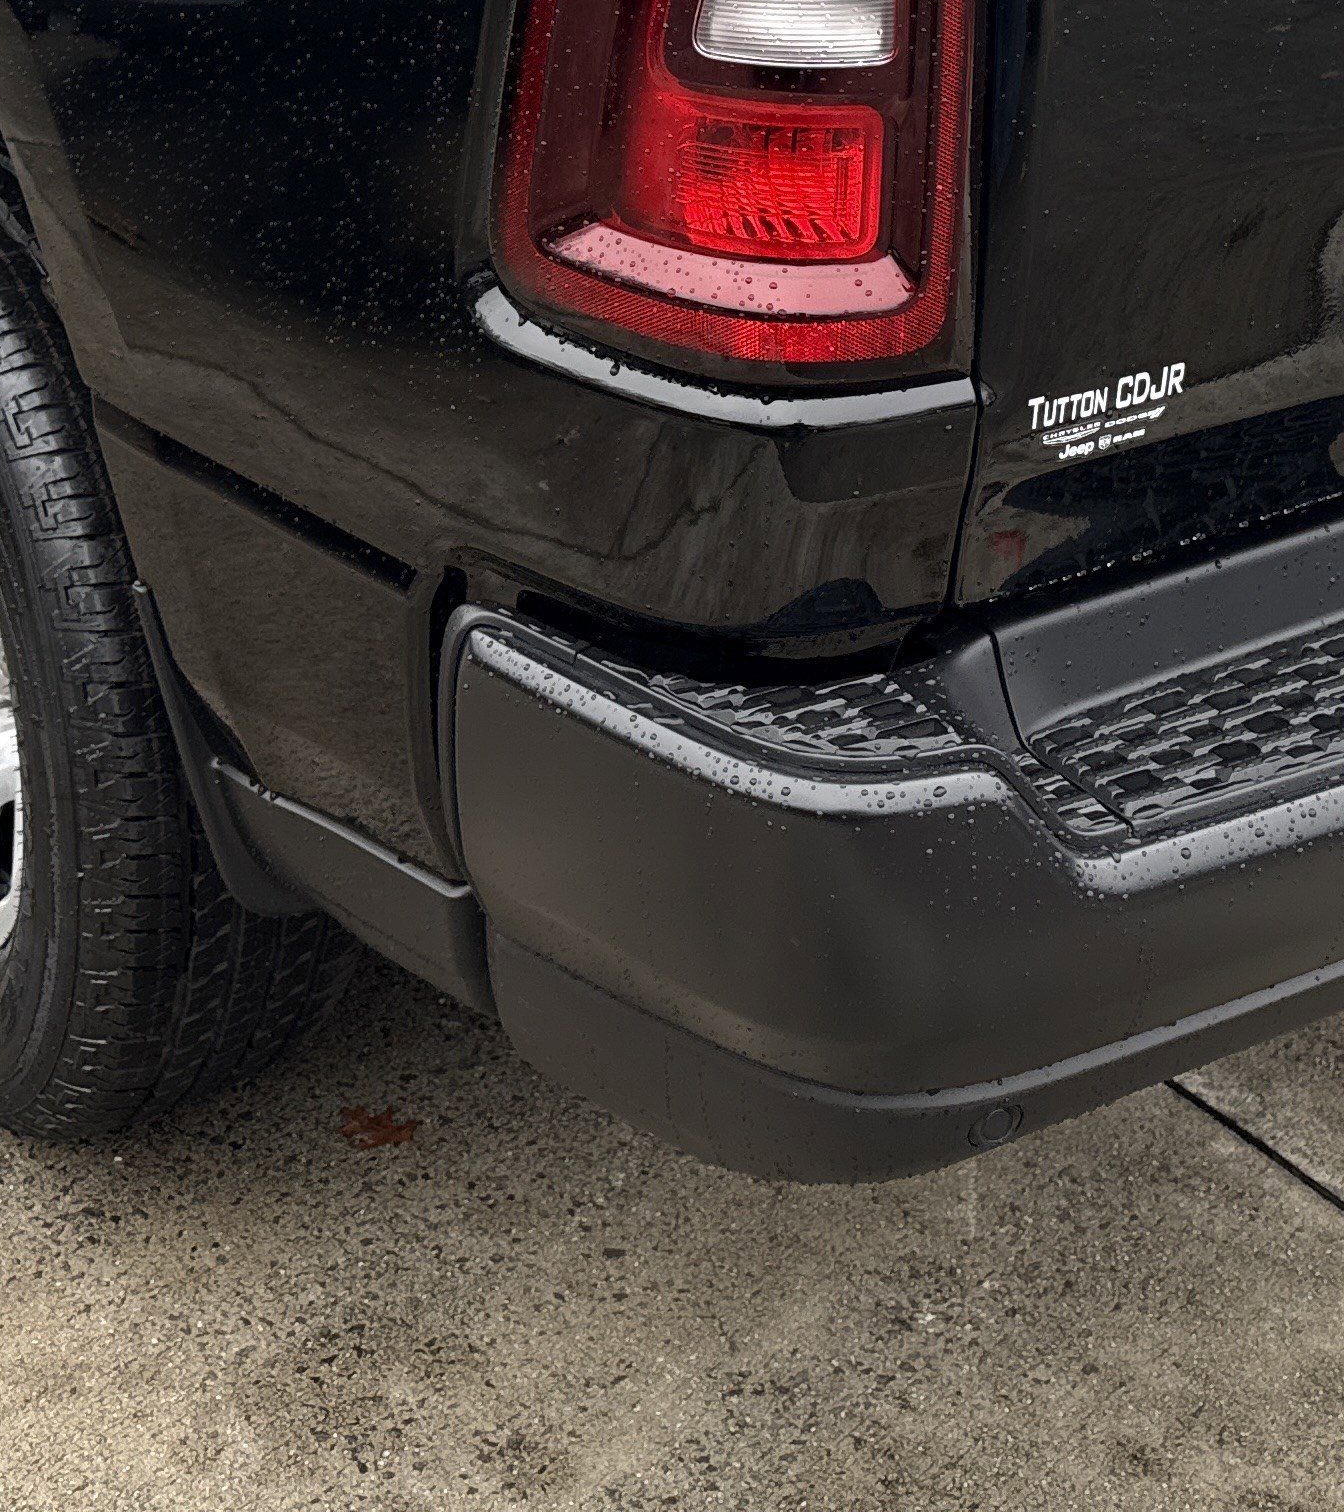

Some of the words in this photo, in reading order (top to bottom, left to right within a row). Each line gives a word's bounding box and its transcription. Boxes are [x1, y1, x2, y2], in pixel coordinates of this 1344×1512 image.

[1028, 387, 1109, 430] TUTTON
[1115, 362, 1185, 410] CDJR
[1058, 441, 1095, 460] Jeep
